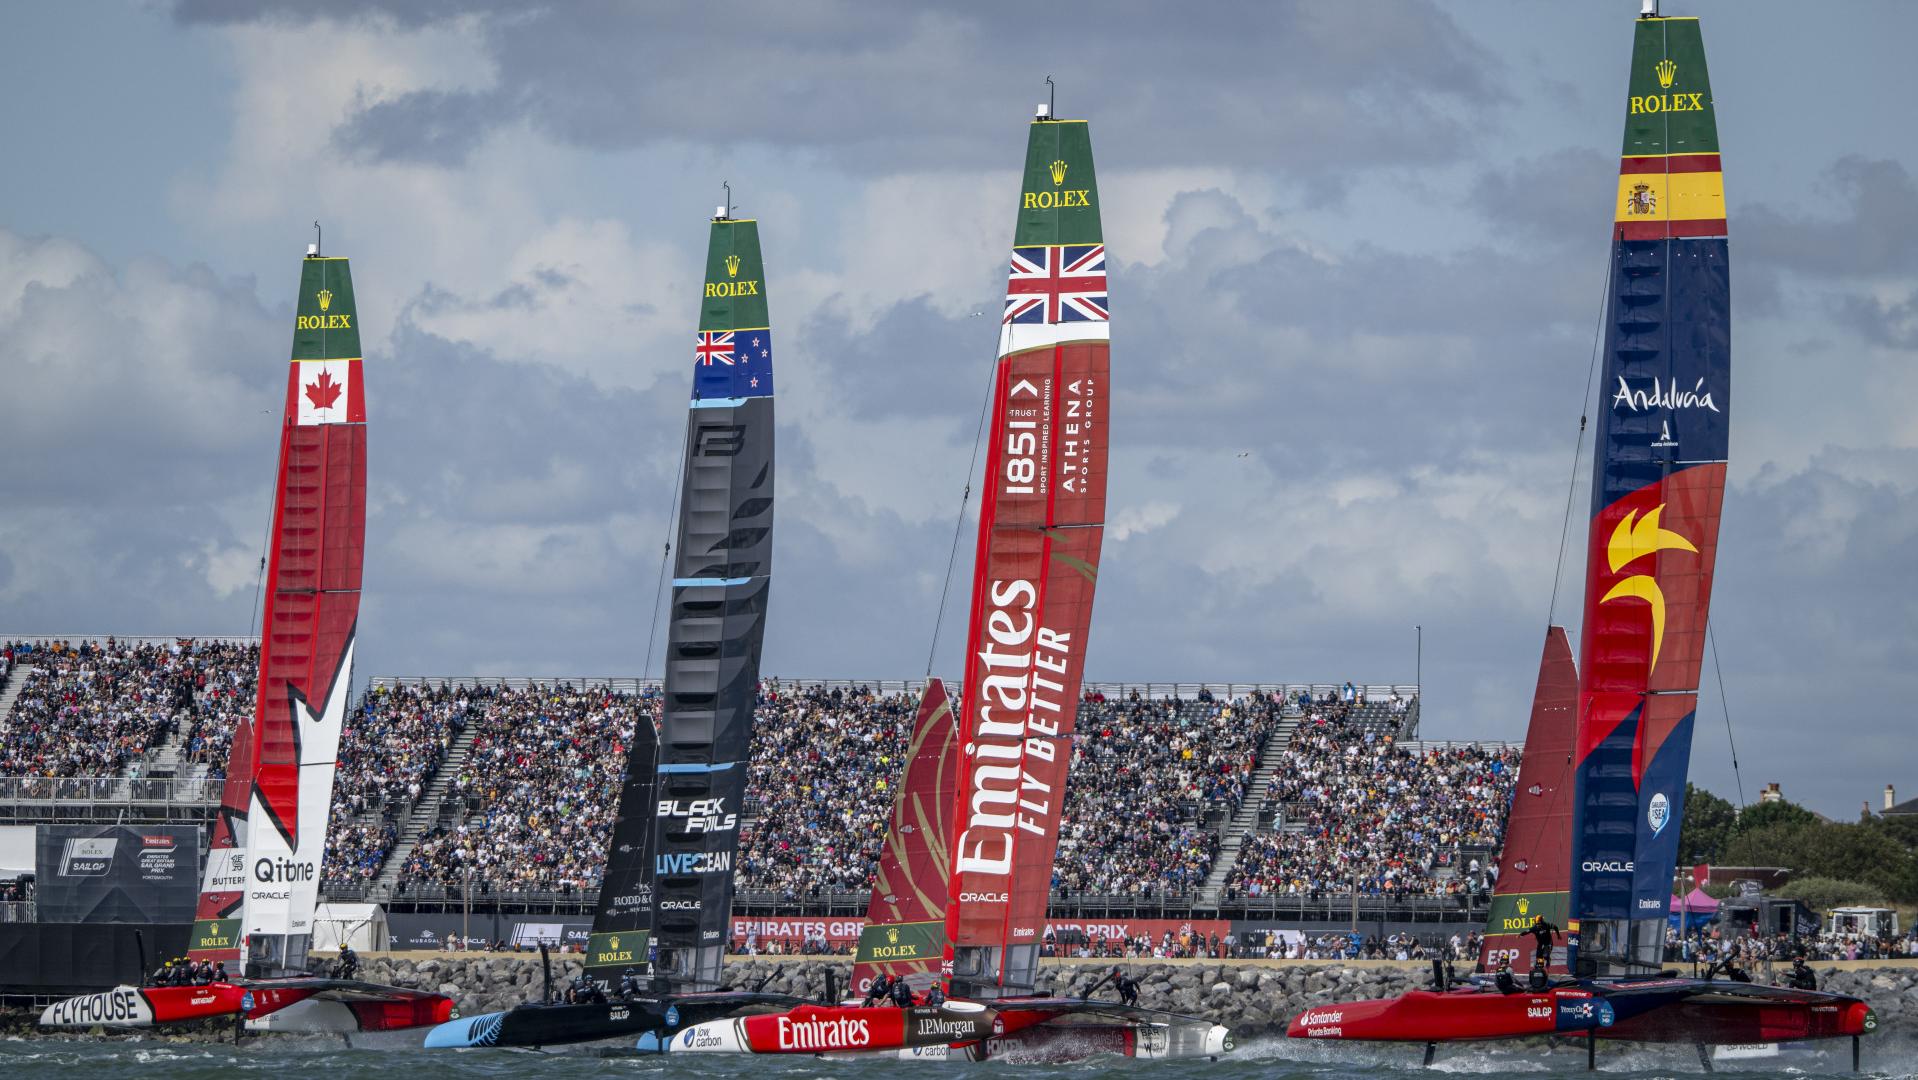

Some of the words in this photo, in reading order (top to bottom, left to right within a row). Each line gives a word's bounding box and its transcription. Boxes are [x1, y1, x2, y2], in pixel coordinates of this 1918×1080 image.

[1631, 93, 1703, 114] ROLEX
[1024, 190, 1090, 208] ROLEX
[705, 280, 758, 297] ROLEX
[298, 315, 351, 329] ROLEX
[1043, 378, 1051, 421] LEARNING
[1041, 424, 1050, 463] INSPIRED
[1062, 379, 1082, 493] ATHENA
[1080, 439, 1090, 493] SPORTS
[1085, 379, 1094, 428] GROUP
[1025, 626, 1071, 762] BETTER
[955, 578, 1037, 876] Emirates
[657, 797, 726, 816] BLACK
[1017, 775, 1052, 836] FLY
[685, 813, 737, 833] FOILS
[1582, 862, 1634, 872] ORACLE
[959, 892, 1008, 902] ORACLE
[1639, 899, 1661, 909] Emirates
[660, 901, 701, 910] ORACLE
[734, 921, 826, 936] EMIRATES
[1013, 927, 1035, 937] Emirates
[1086, 924, 1128, 939] PRIX
[201, 937, 229, 946] ROLEX
[598, 951, 633, 962] ROLEX
[873, 945, 917, 957] ROLEX
[53, 991, 138, 1025] FLYHOUSE
[1308, 1011, 1343, 1025] Santander
[697, 1027, 710, 1037] low
[778, 1014, 870, 1049] Emirates
[1308, 1027, 1324, 1037] Private
[1323, 1026, 1342, 1037] Banking
[696, 1035, 722, 1048] carbon
[925, 1044, 951, 1056] carbon
